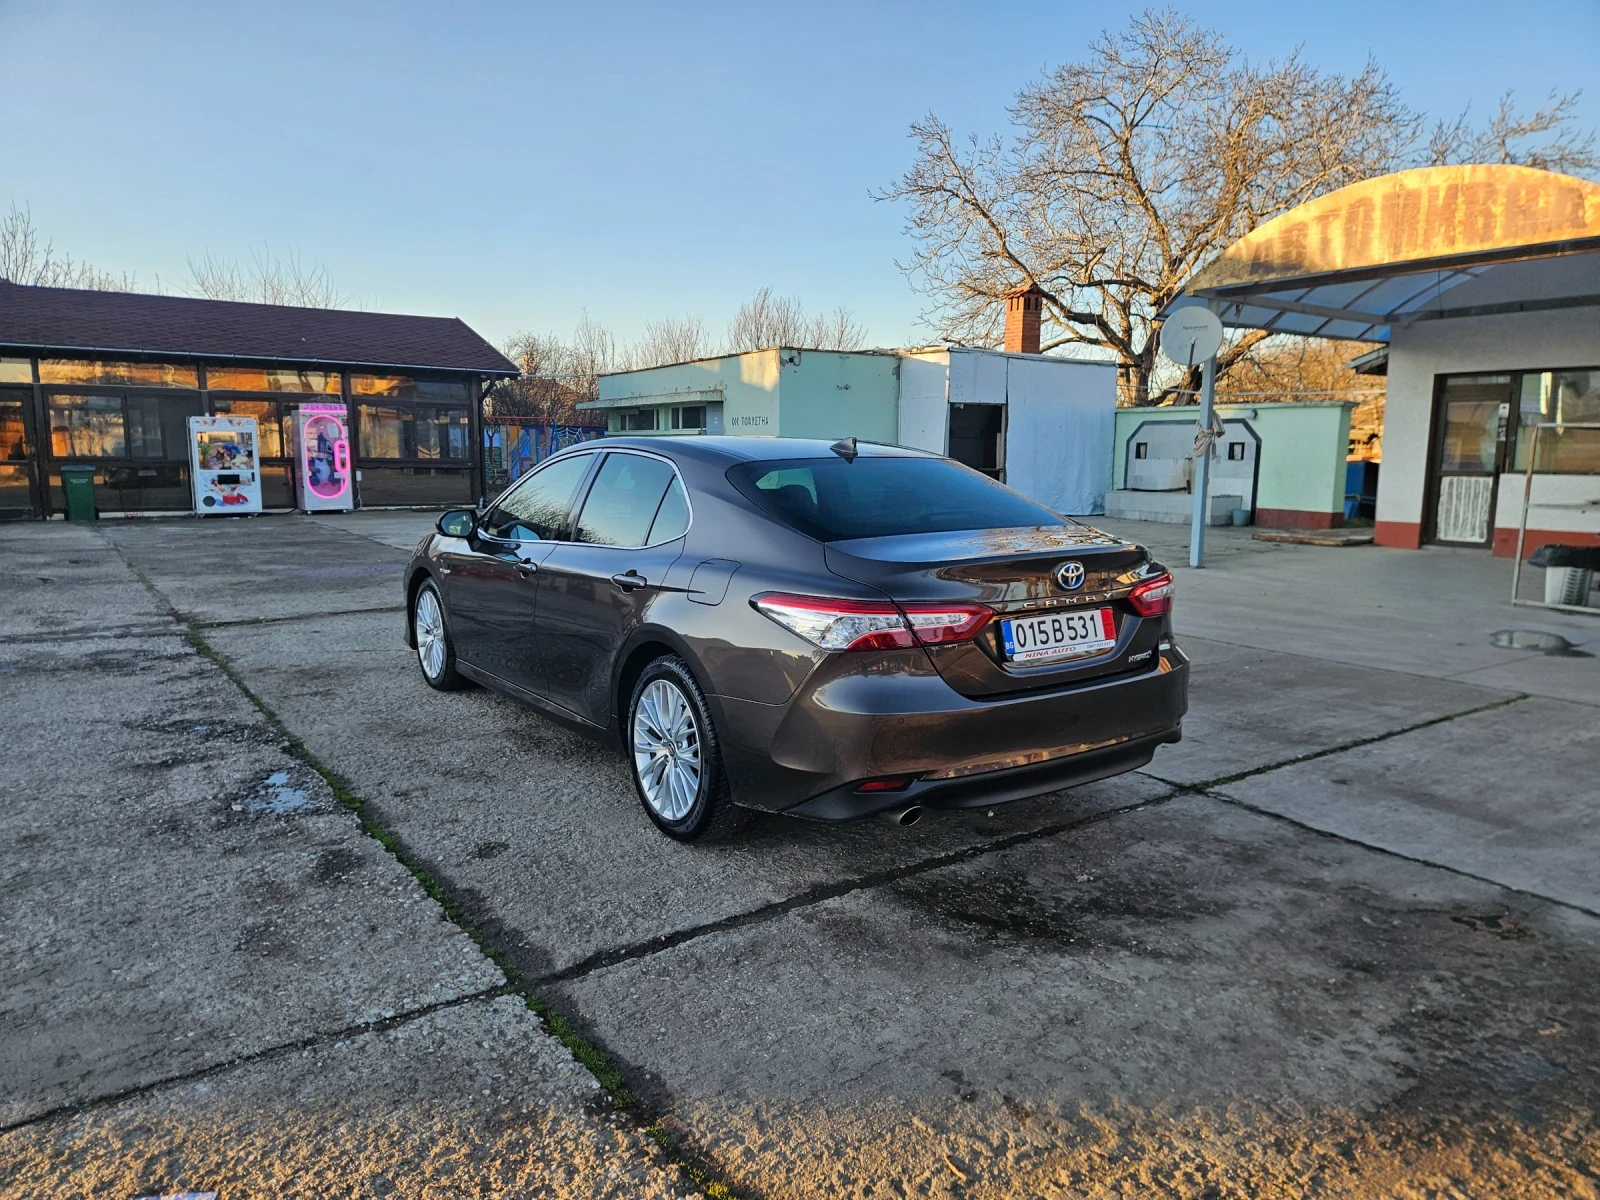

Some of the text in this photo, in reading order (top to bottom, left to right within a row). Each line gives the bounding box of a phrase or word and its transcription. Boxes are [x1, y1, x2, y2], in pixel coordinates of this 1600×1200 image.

[1023, 592, 1112, 608] CAMRY
[1015, 614, 1098, 648] 015B531
[1005, 641, 1014, 650] BG
[1024, 646, 1077, 659] NINA AUTO
